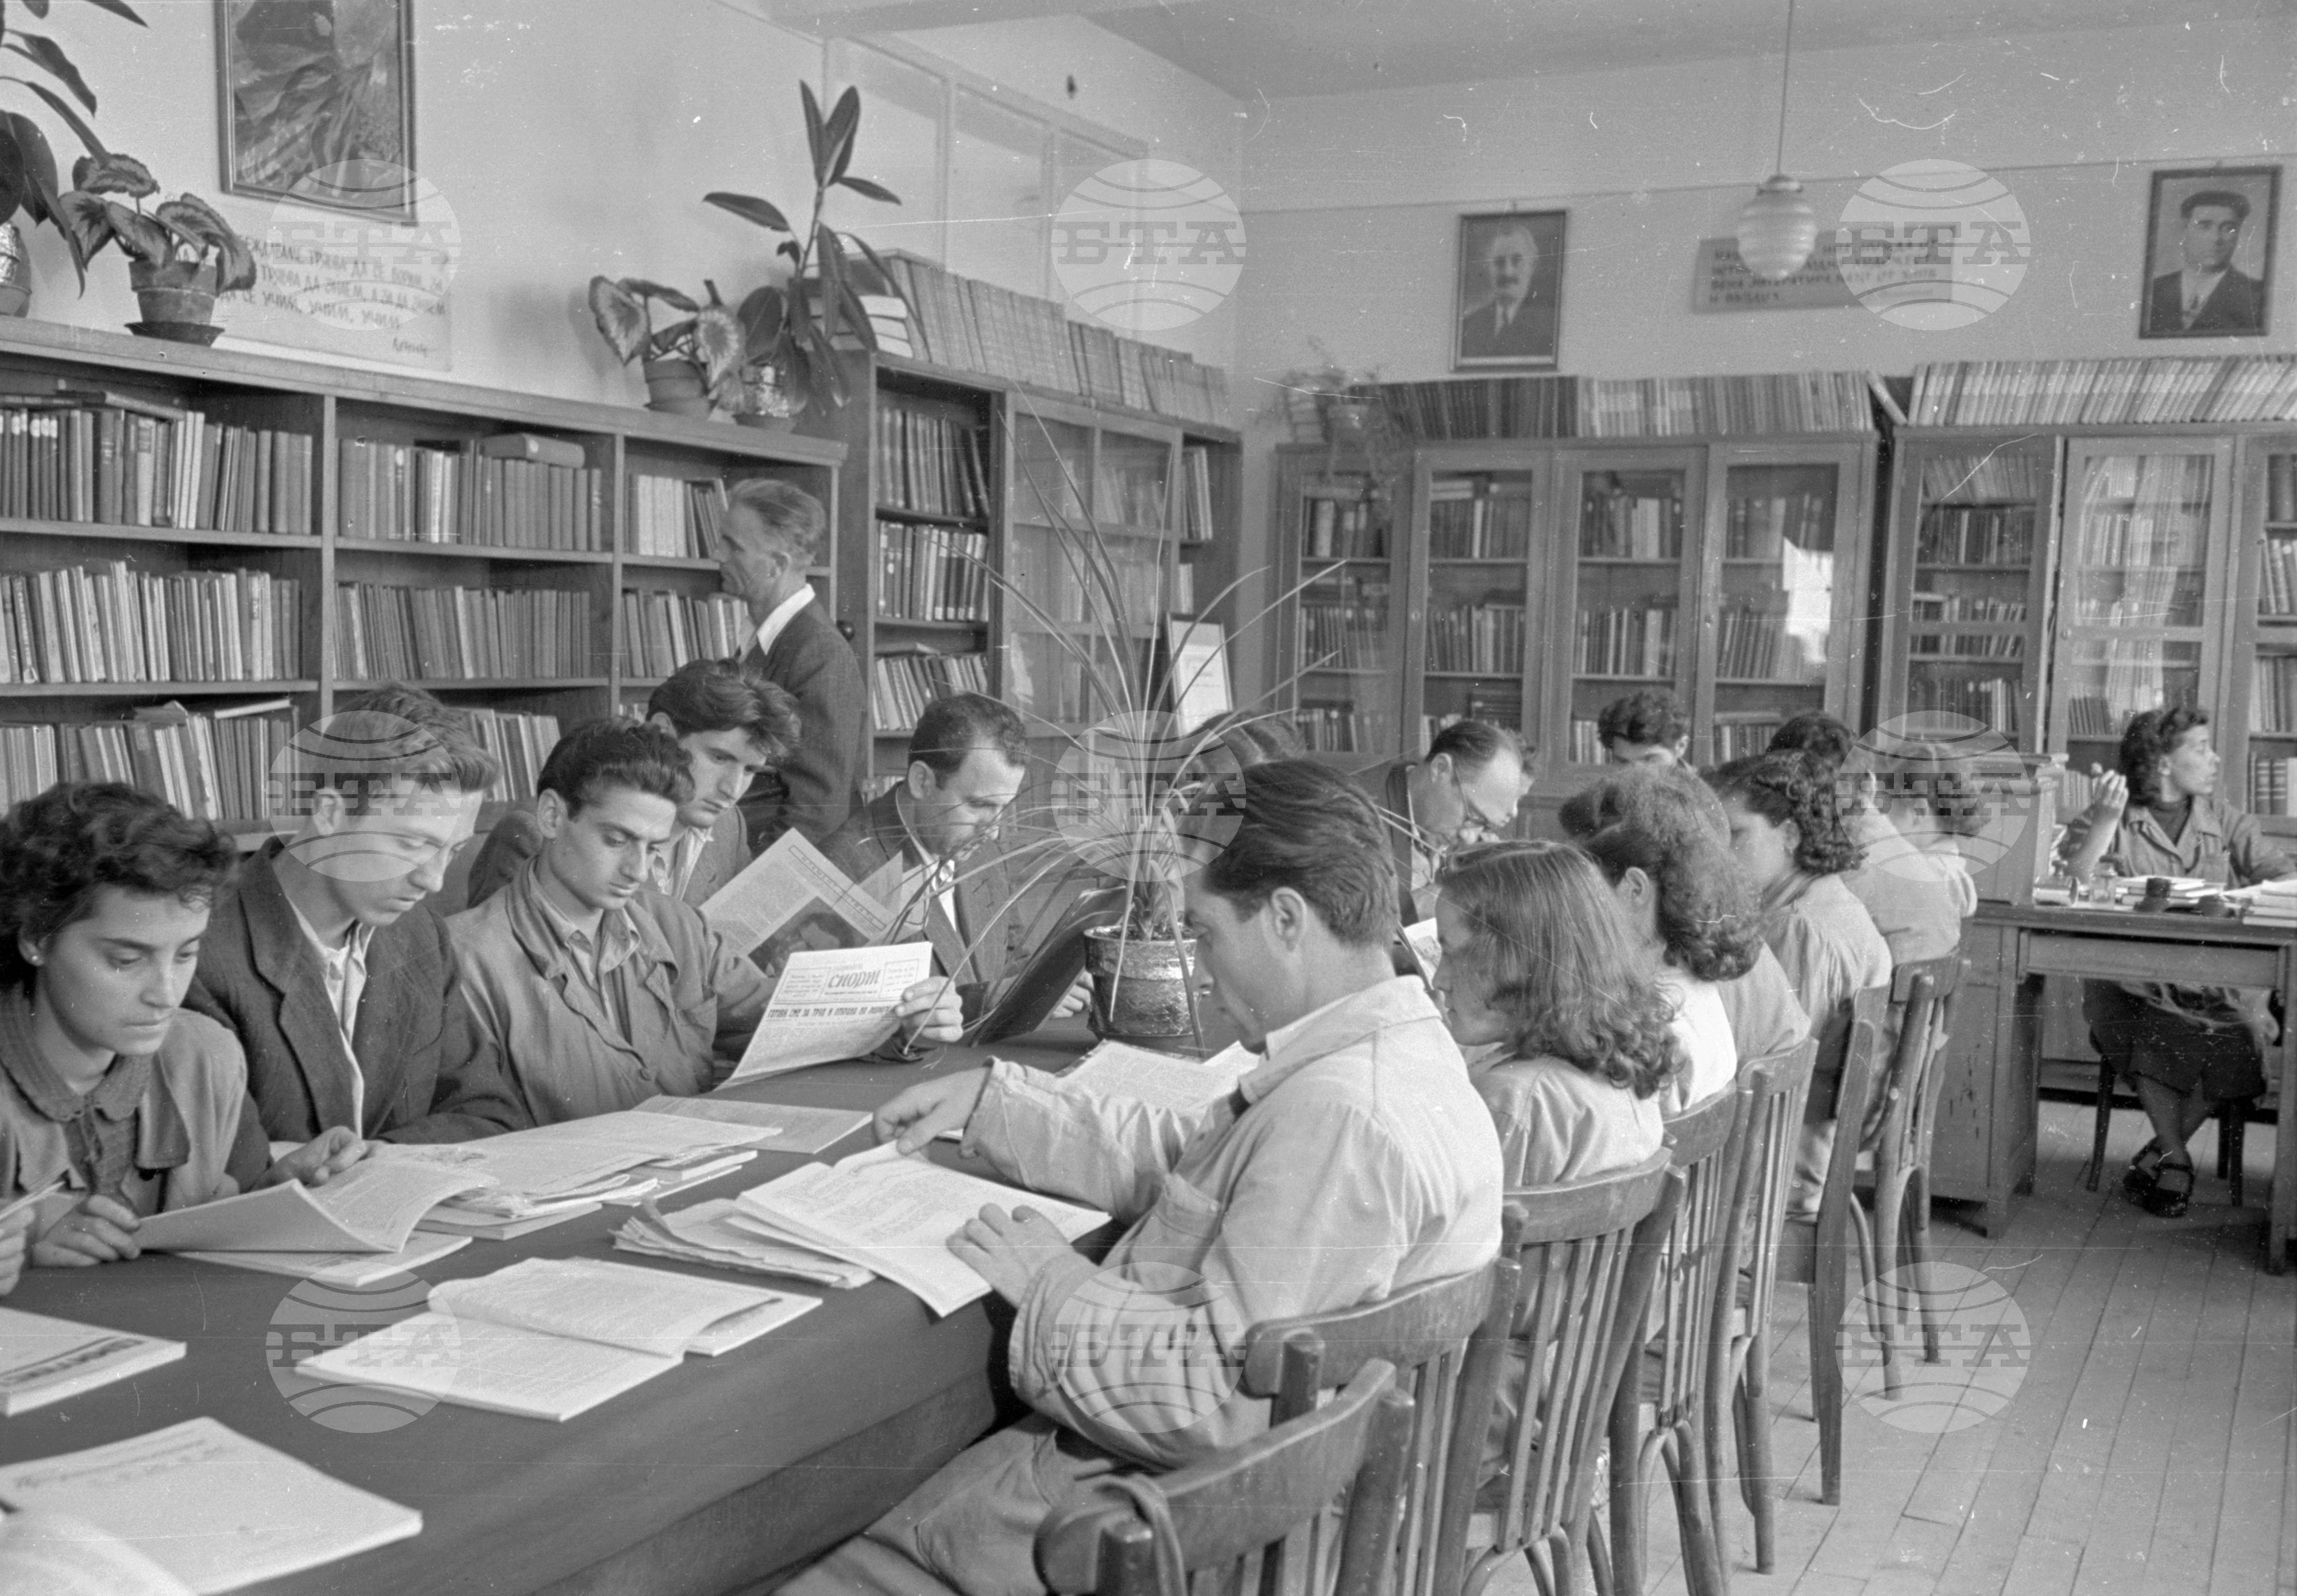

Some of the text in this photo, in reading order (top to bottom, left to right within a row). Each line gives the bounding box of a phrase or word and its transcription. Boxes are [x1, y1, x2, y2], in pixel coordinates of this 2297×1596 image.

[351, 260, 368, 278] ДА
[373, 264, 385, 280] СЕ
[304, 275, 319, 293] ДА
[396, 293, 408, 310] ДА
[243, 291, 256, 304] СЕ
[362, 309, 400, 329] УЧИМ
[789, 1008, 802, 1018] СМЕ
[802, 1008, 810, 1017] ЗА
[813, 1008, 826, 1017] ТРУД
[827, 1008, 834, 1017] И
